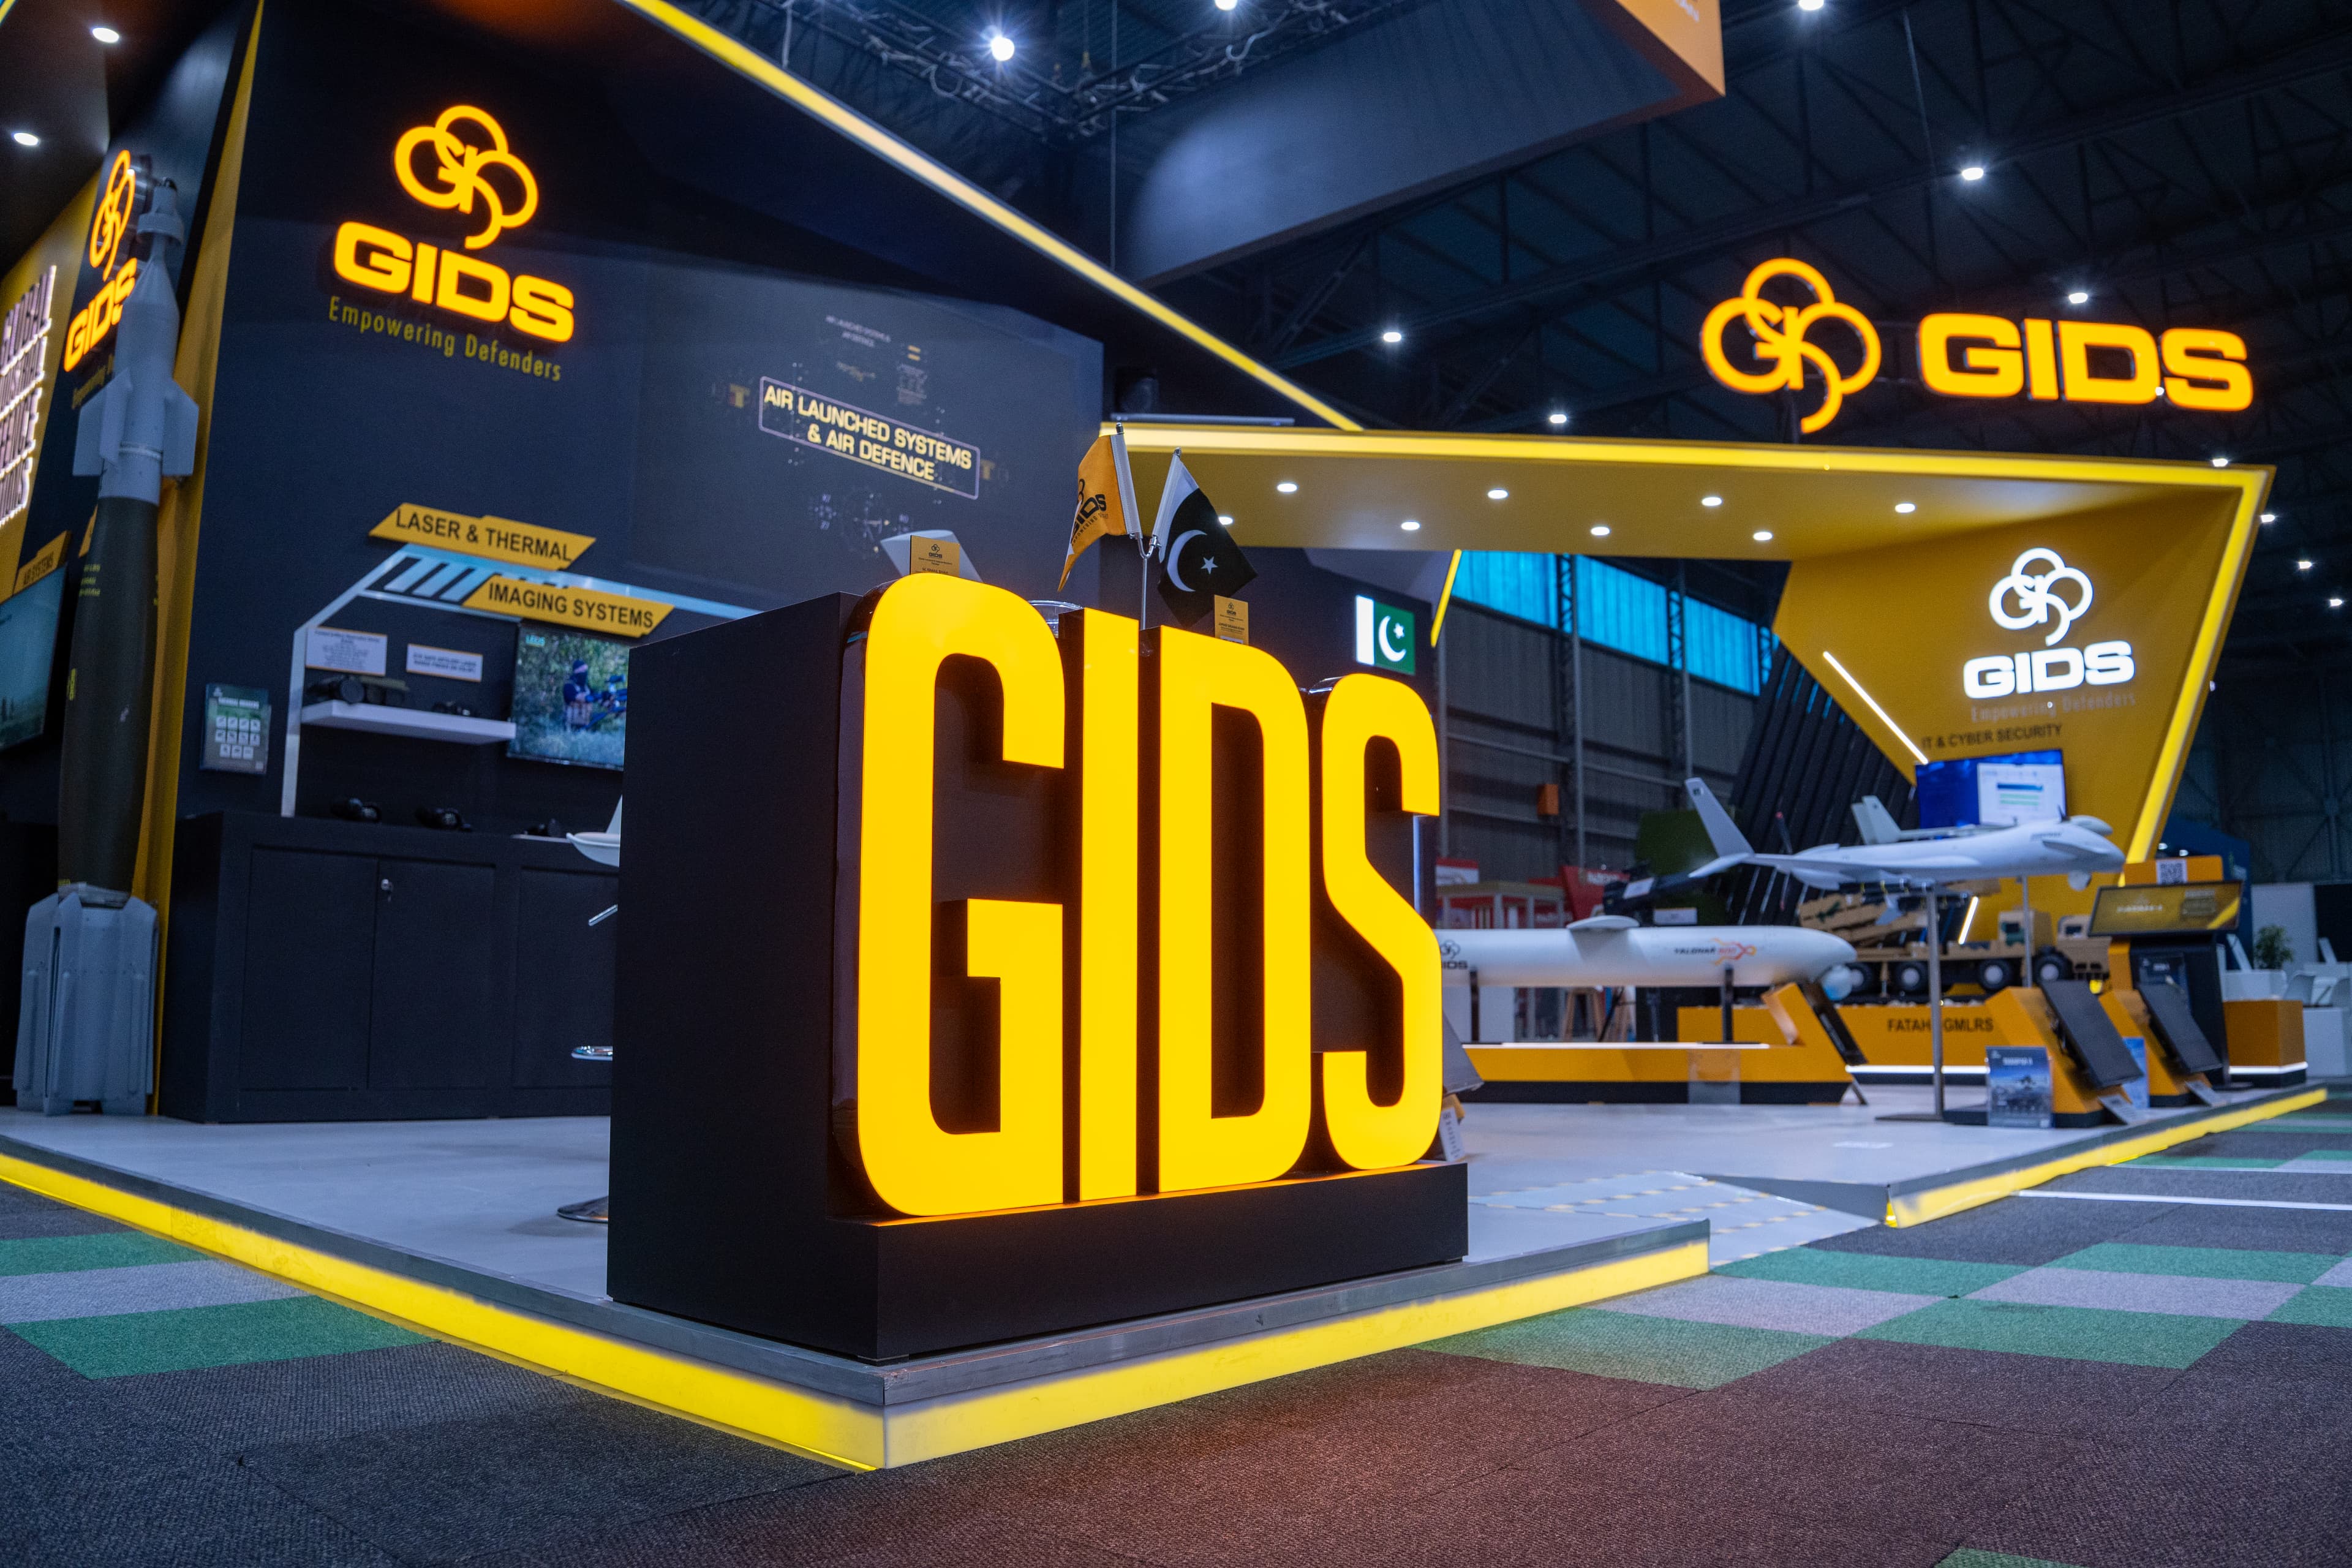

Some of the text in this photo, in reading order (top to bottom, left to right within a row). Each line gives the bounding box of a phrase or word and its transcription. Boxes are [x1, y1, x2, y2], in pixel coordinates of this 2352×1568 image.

[334, 221, 575, 343] GIDS
[64, 258, 137, 372] GIDS
[329, 296, 562, 382] Empowering Defenders
[1917, 312, 2254, 412] GIDS
[764, 385, 972, 470] AIR LAUNCHED SYSTEMS
[807, 423, 935, 481] & AIR DEFENCE
[395, 508, 572, 562] LASER & THERMAL
[488, 582, 654, 628] IMAGING SYSTEMS
[1963, 640, 2136, 699] GIDS
[2062, 692, 2136, 713] Defenders
[1921, 737, 1932, 749] IT
[1948, 733, 1993, 747] CYBER
[1996, 723, 2062, 742] SECURITY
[858, 572, 1442, 1217] GIDS
[1442, 960, 1468, 970] IDS
[1887, 1017, 1995, 1033] FATAH GMLRS
